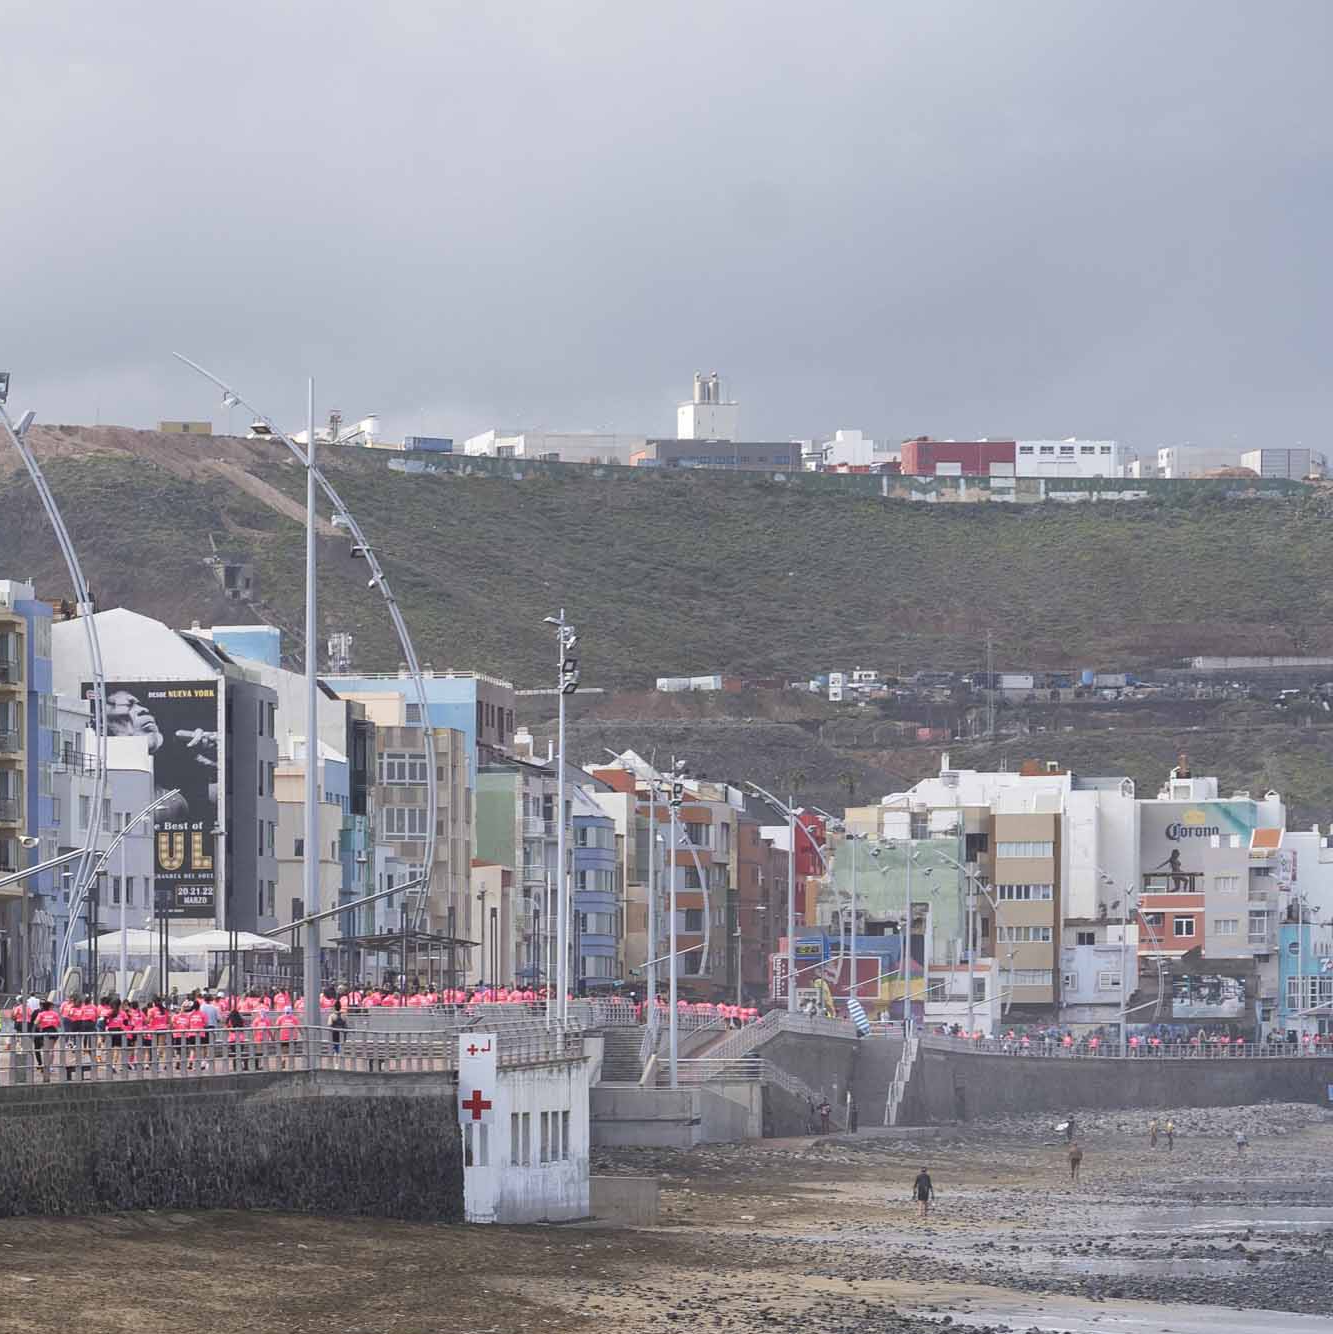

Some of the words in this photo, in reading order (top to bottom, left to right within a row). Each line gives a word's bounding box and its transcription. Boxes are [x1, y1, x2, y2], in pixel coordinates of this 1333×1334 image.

[168, 690, 192, 698] NUEVA
[194, 689, 214, 697] YORK
[164, 821, 188, 830] Best
[192, 821, 204, 830] of
[157, 831, 213, 871] UL
